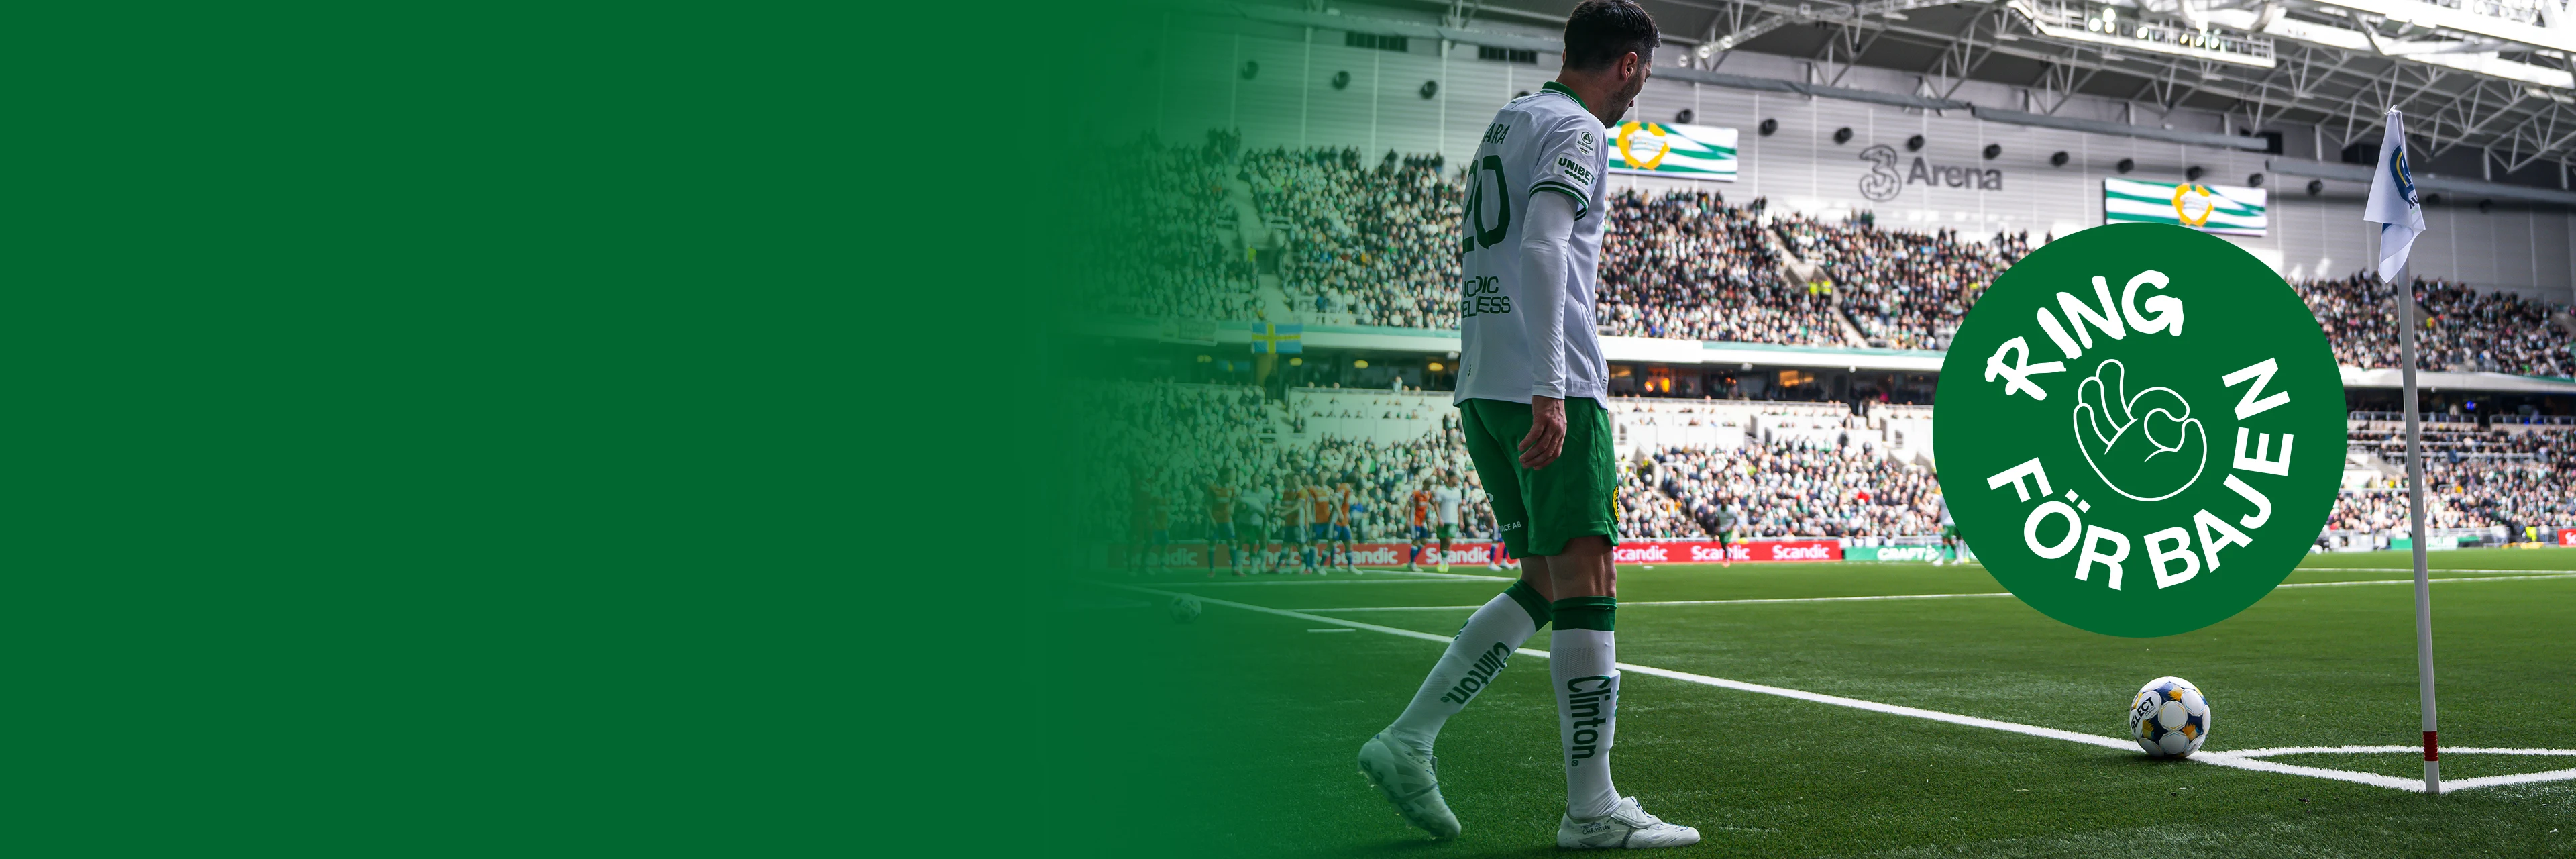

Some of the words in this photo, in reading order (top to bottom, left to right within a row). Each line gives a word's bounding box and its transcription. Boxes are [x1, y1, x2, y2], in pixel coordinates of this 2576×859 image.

[1483, 123, 1510, 144] ARA
[1558, 157, 1595, 185] UNIBET
[1907, 156, 2002, 191] Arena
[1462, 155, 1511, 254] 20
[1513, 521, 1521, 529] AB
[1772, 544, 1830, 560] Scandic
[1877, 546, 1927, 561] CRAFT
[2131, 697, 2154, 734] SELECT
